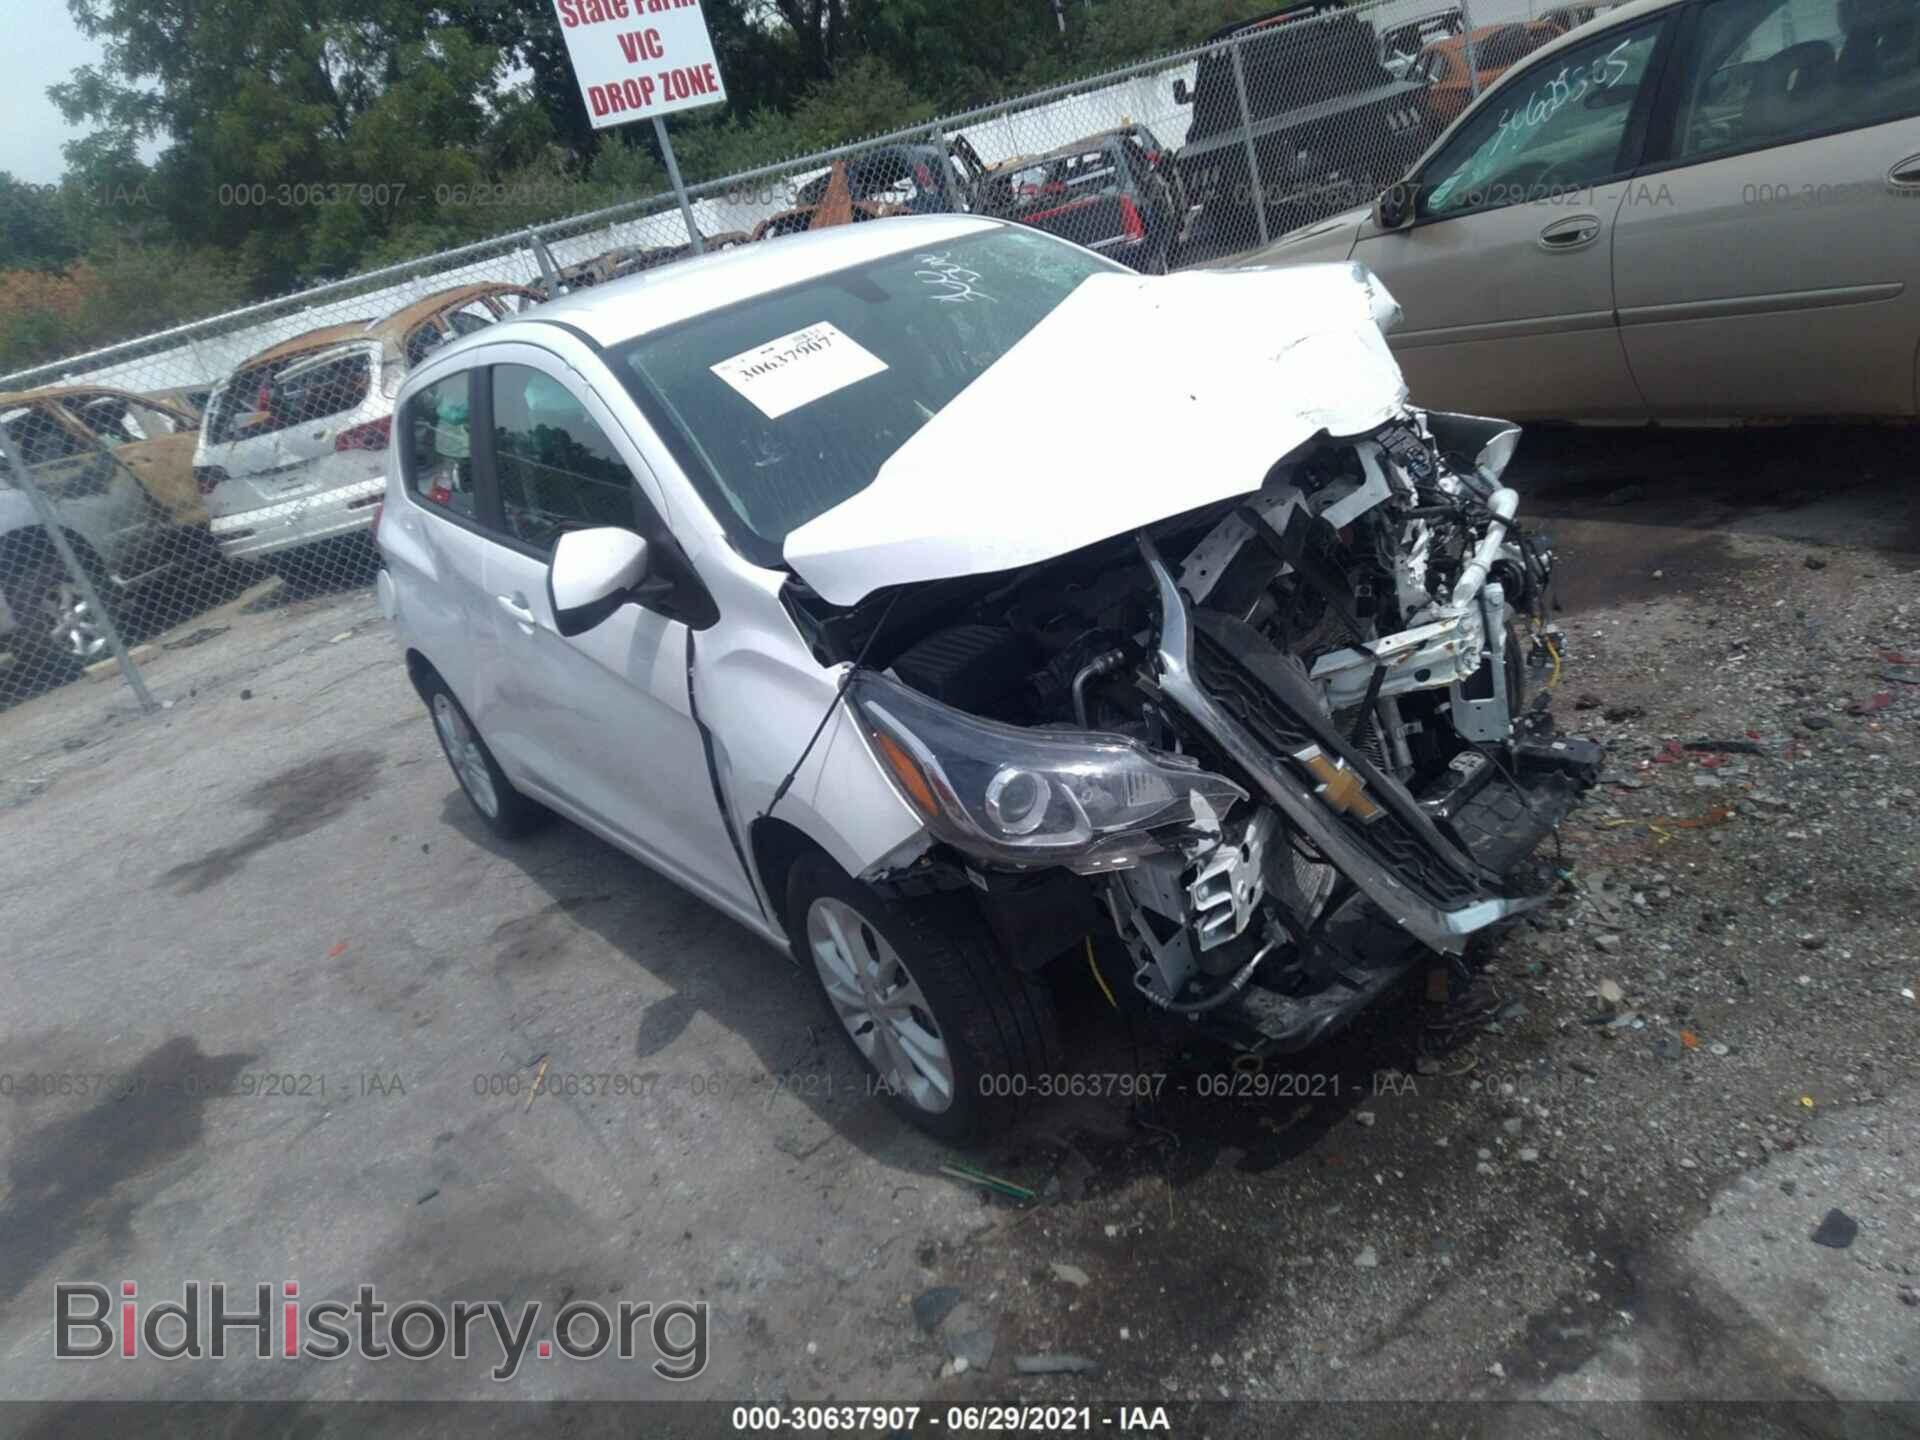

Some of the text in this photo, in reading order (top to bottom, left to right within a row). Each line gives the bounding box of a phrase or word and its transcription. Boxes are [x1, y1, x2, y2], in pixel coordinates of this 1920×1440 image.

[558, 0, 629, 27] State
[617, 28, 664, 63] VIC
[587, 63, 719, 117] DROP ZONE
[740, 336, 832, 382] 30637907
